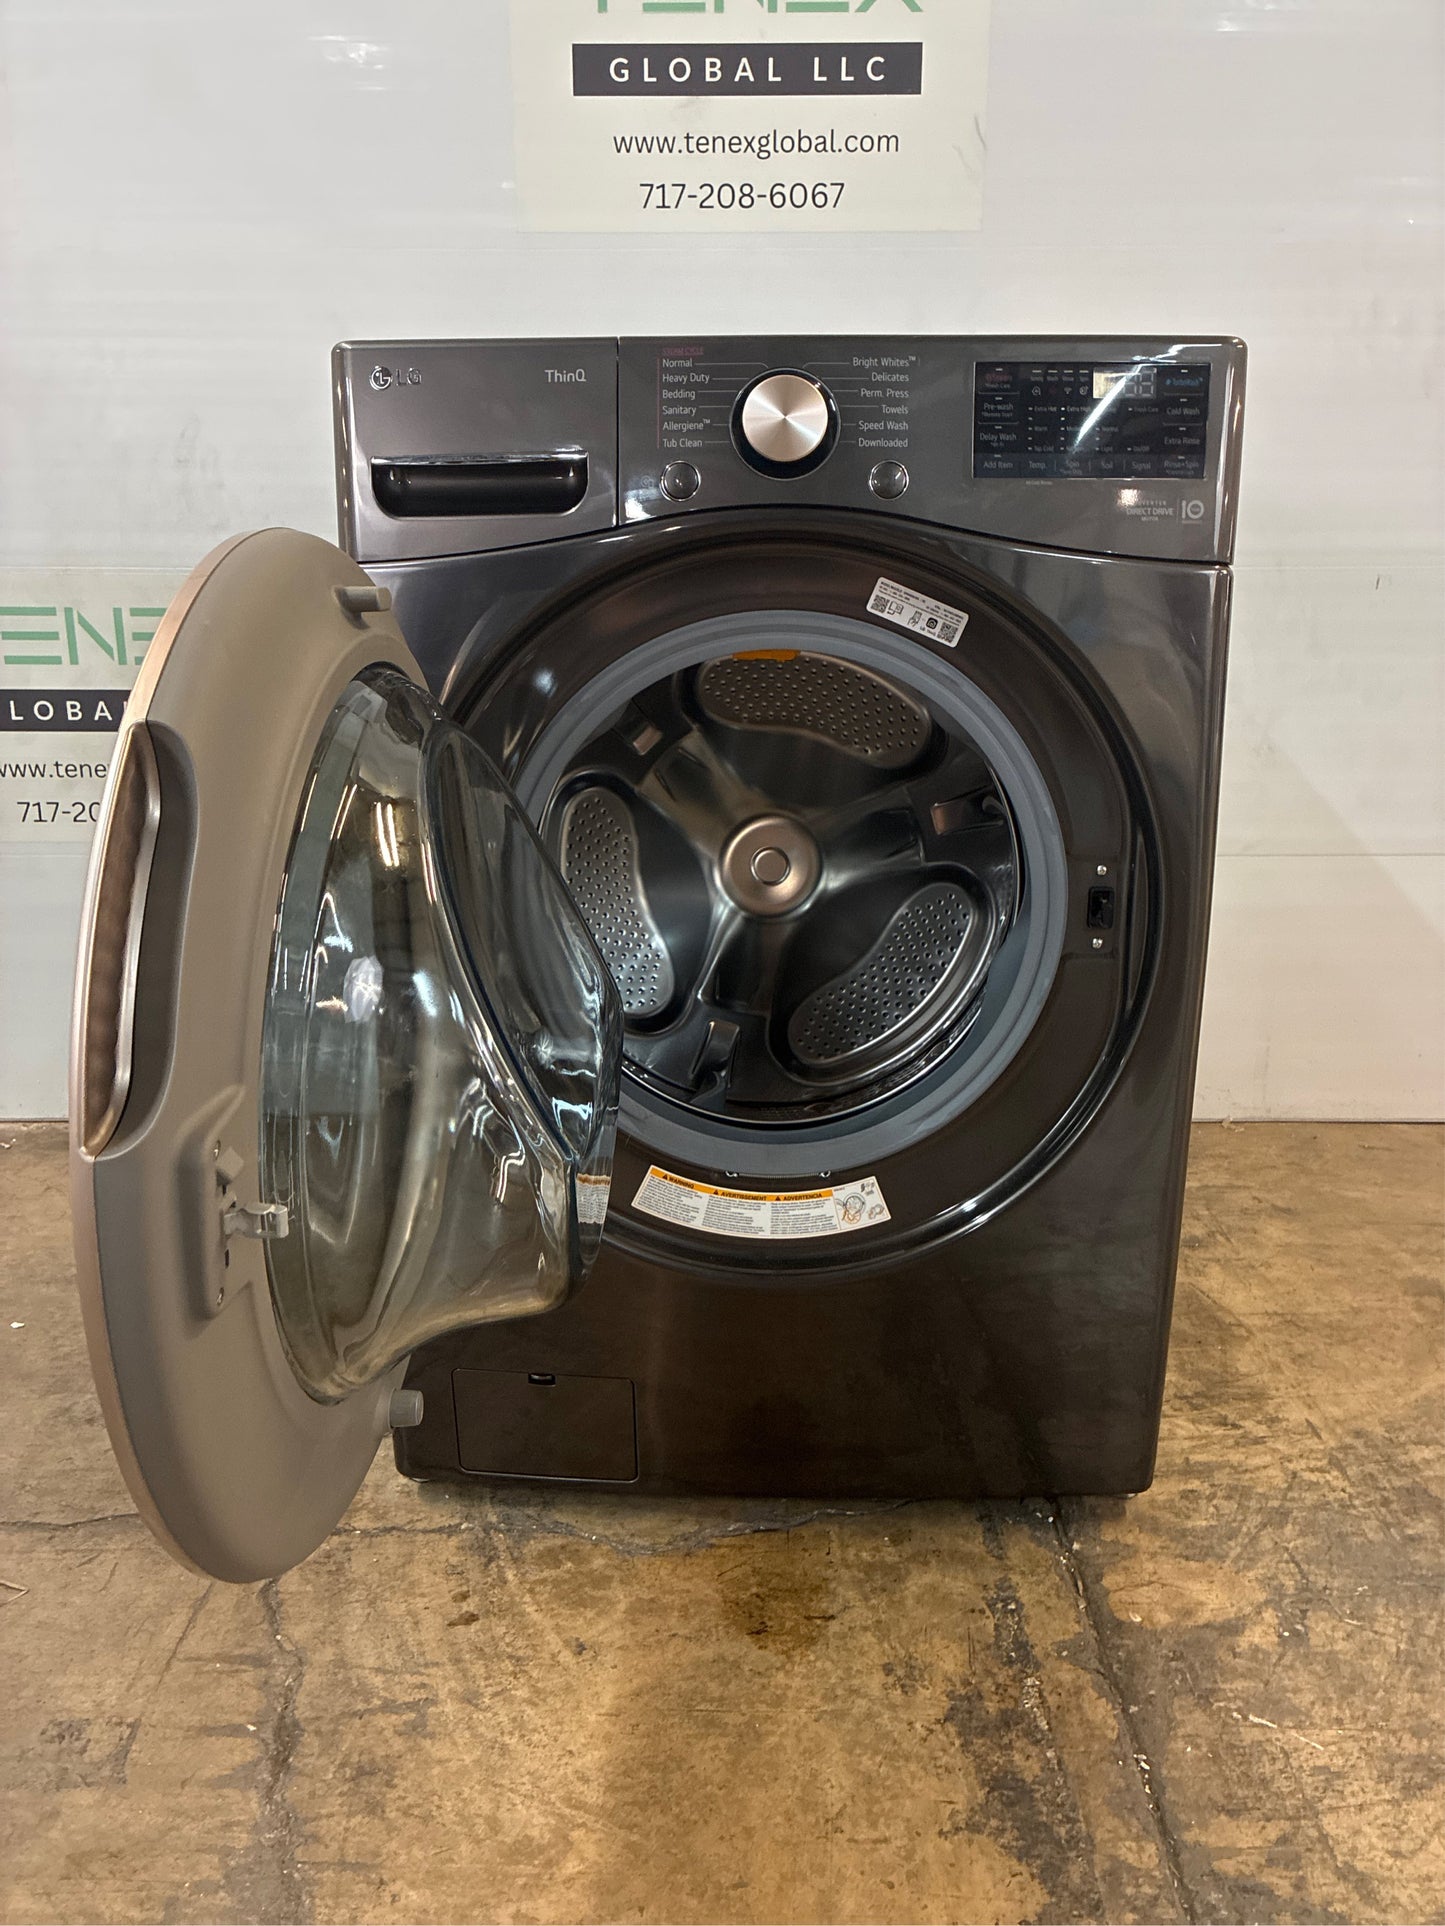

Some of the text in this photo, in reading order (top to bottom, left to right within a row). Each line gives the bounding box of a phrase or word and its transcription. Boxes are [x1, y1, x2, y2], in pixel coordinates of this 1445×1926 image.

[609, 55, 887, 83] GLOBAL LLC
[613, 129, 900, 160] www.tenexglobal.com
[639, 182, 846, 209] 717-208-6067
[662, 357, 693, 368] Normal
[852, 356, 879, 369] Bright
[544, 368, 587, 383] ThinQ
[662, 372, 710, 385] Heavy Duty
[871, 371, 910, 382] Delicates
[662, 389, 696, 401] Bedding
[886, 388, 910, 398] Press
[662, 405, 697, 417] Sanitary
[880, 404, 909, 414] Towels
[858, 420, 909, 432] Speed Wash
[662, 438, 703, 448] Tub Clean
[858, 437, 909, 448] Downloaded
[1125, 506, 1175, 516] DIRECT DRIVE
[668, 1175, 696, 1190] WARNING
